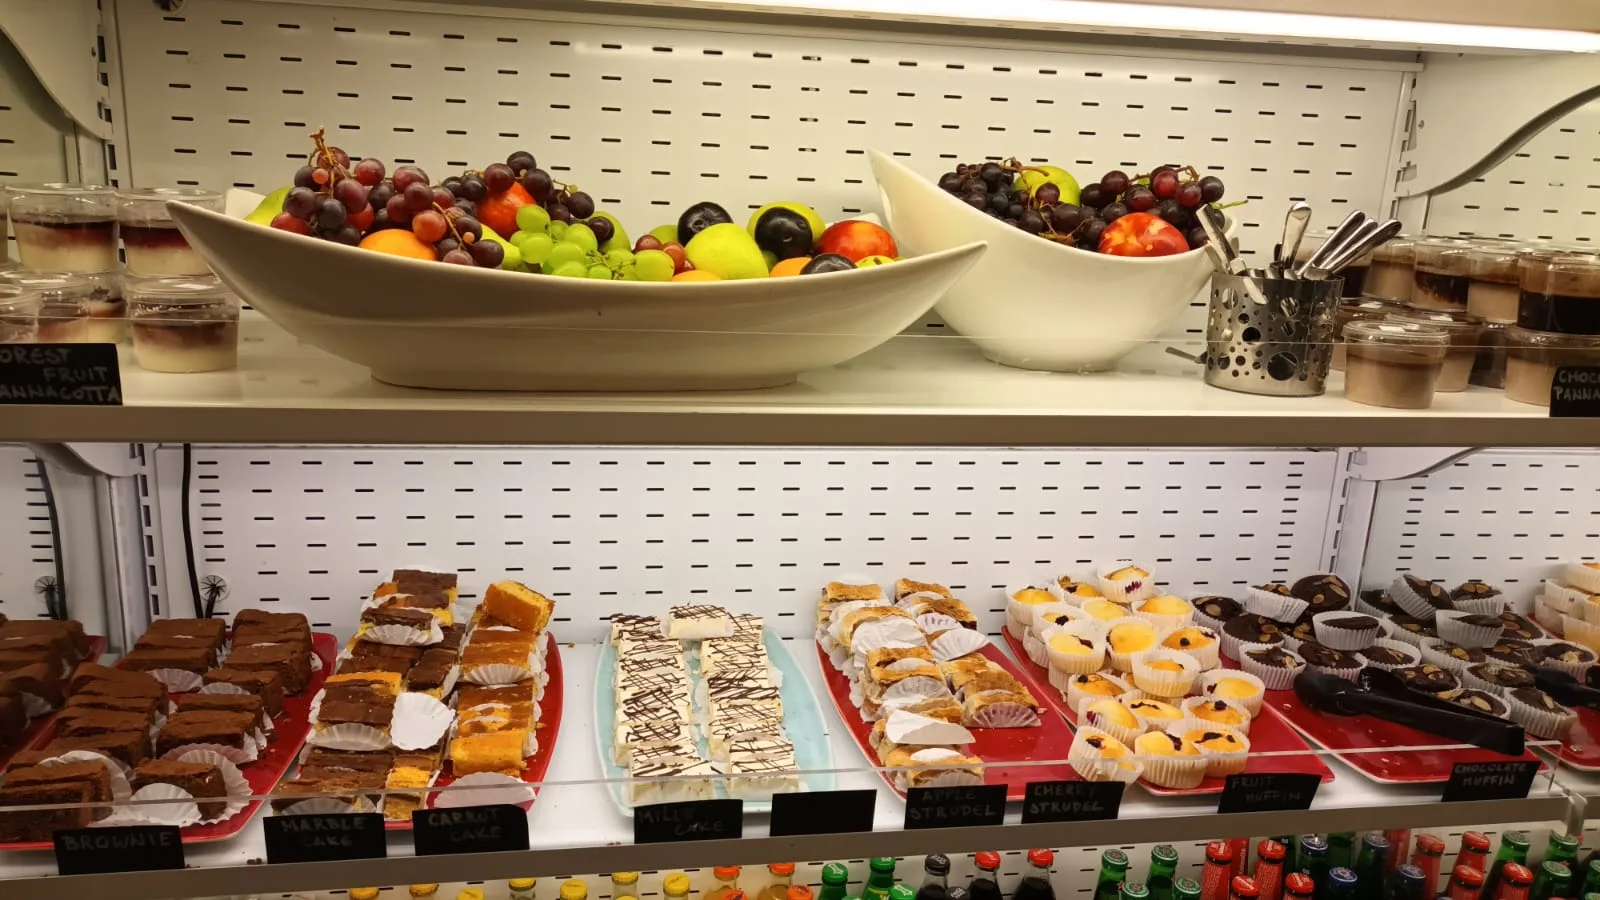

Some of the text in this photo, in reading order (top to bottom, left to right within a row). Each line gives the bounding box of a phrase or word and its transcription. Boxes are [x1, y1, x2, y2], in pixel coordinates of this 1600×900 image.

[0, 347, 72, 364] OREST
[43, 366, 108, 382] FRUIT
[0, 384, 120, 403] ANNACOTTA
[1454, 763, 1527, 774] CHOCOLATE
[1232, 776, 1275, 789] FRUIT
[1463, 775, 1516, 787] MUFFIN
[922, 789, 977, 801] APPLE
[1034, 783, 1097, 798] CHERRY
[1245, 790, 1302, 803] MUFFIN
[910, 804, 997, 820] STRUDEL
[1030, 801, 1104, 814] STRUDEL
[281, 817, 367, 832] MARBLE
[428, 808, 500, 826] CARROT
[450, 826, 502, 842] CAKE
[674, 820, 724, 836] CAKE
[62, 831, 173, 851] BROWNIE
[304, 835, 352, 847] CAKE
